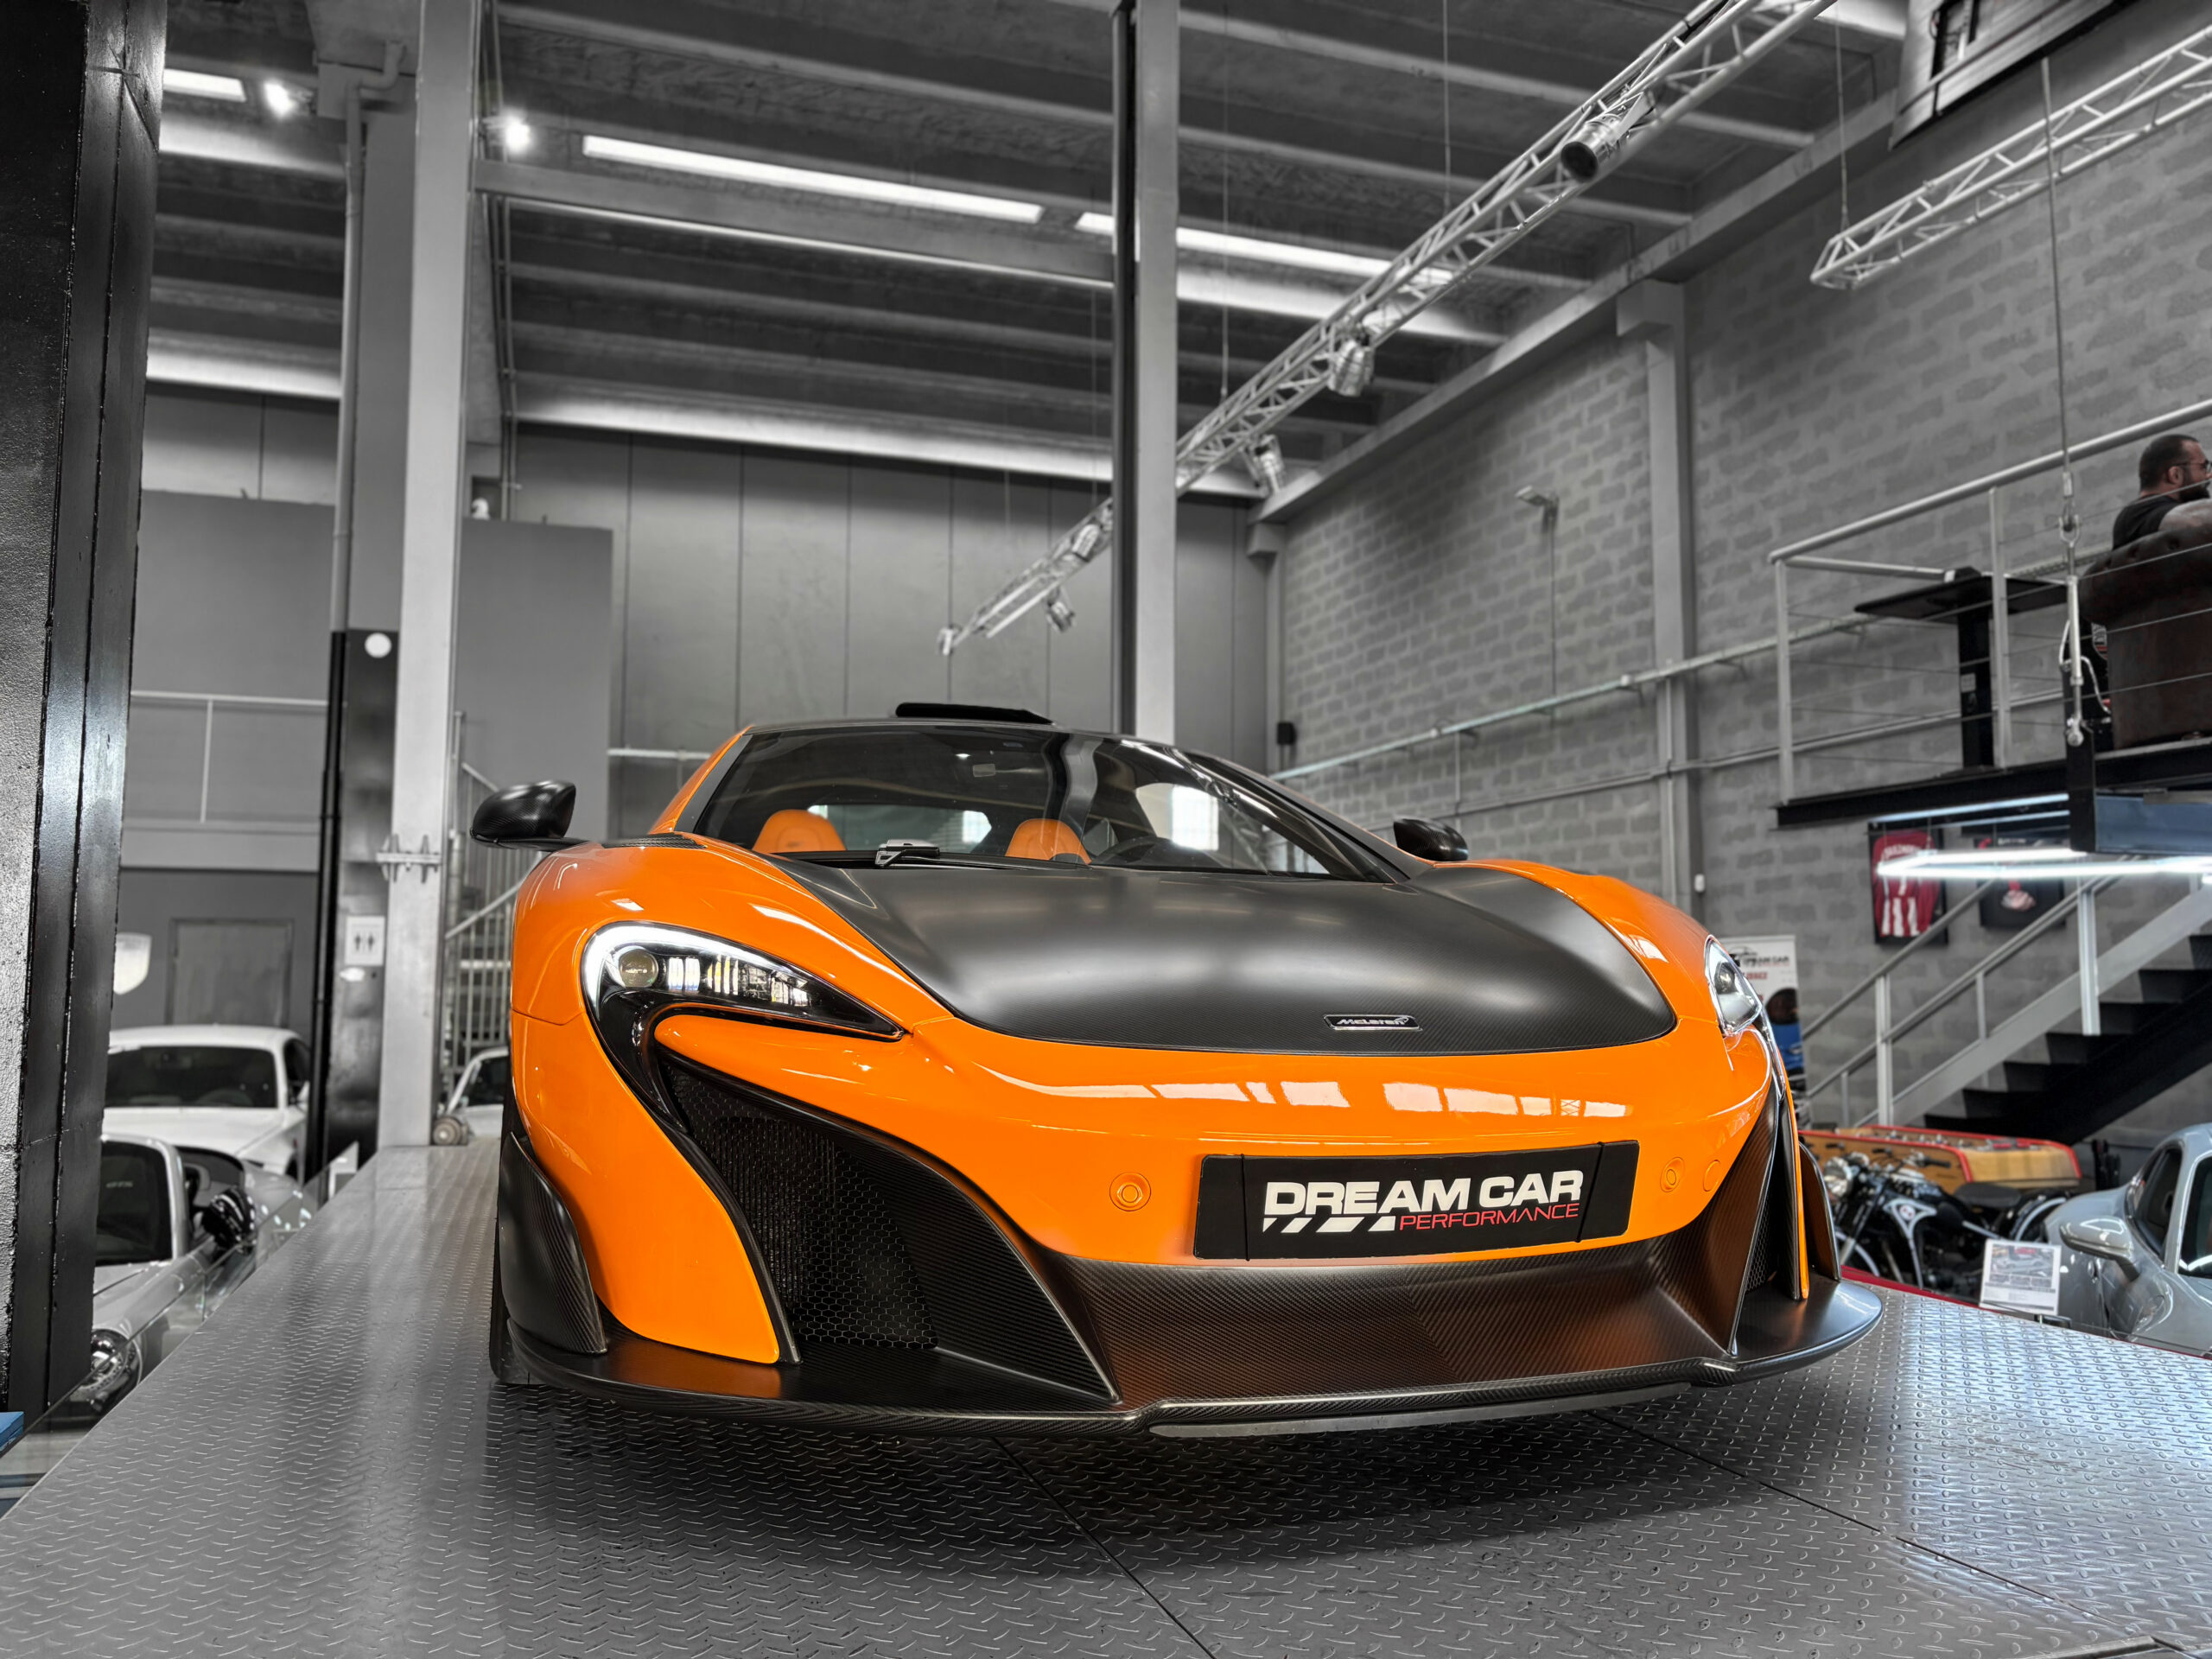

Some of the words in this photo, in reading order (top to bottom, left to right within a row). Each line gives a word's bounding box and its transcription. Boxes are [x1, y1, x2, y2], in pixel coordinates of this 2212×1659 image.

[1264, 1178, 1471, 1216] DREAM
[1478, 1170, 1584, 1208] CAR
[1399, 1203, 1580, 1231] PERFORMANCE
